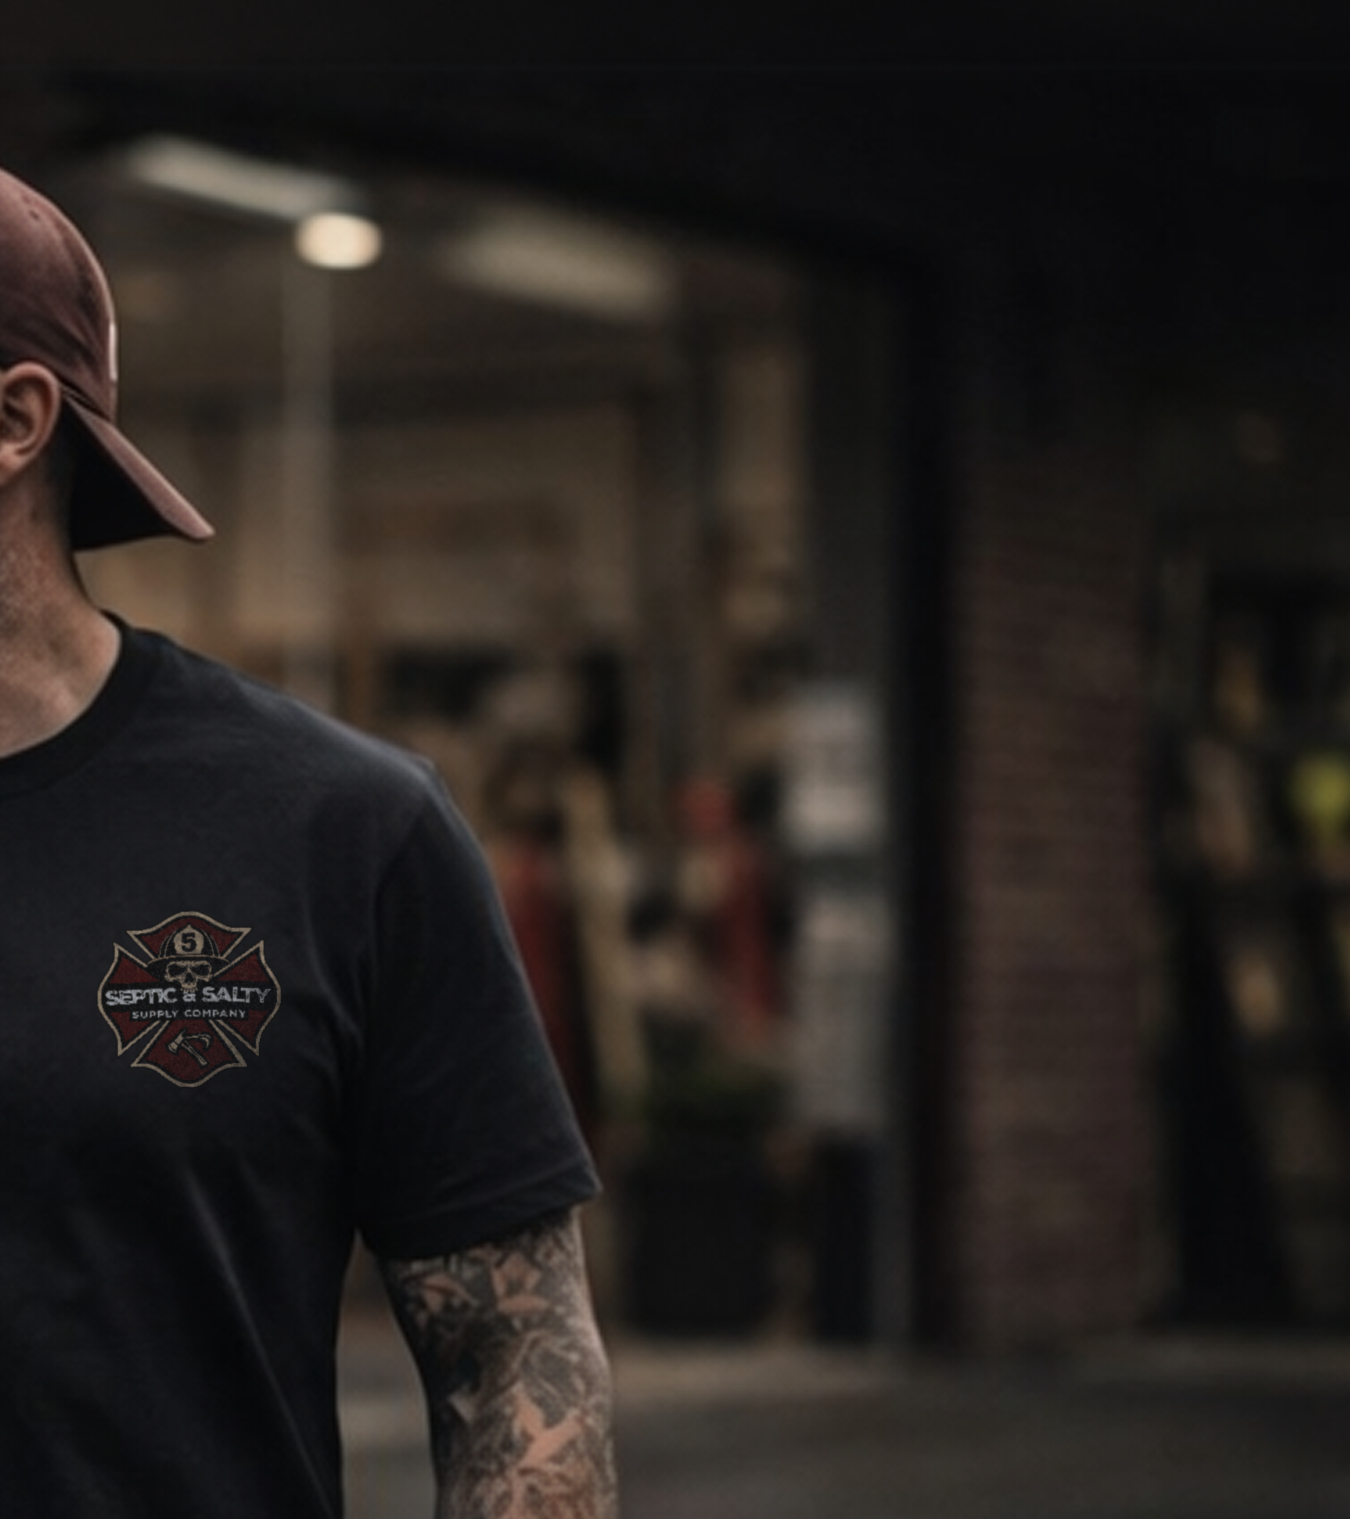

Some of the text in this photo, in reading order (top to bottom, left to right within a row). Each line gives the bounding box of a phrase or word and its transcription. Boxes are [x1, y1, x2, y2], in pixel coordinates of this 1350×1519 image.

[181, 932, 196, 952] 5
[105, 986, 271, 1006] SEPTIC & SALTY
[132, 1009, 247, 1019] SUPPLY COMPANY
